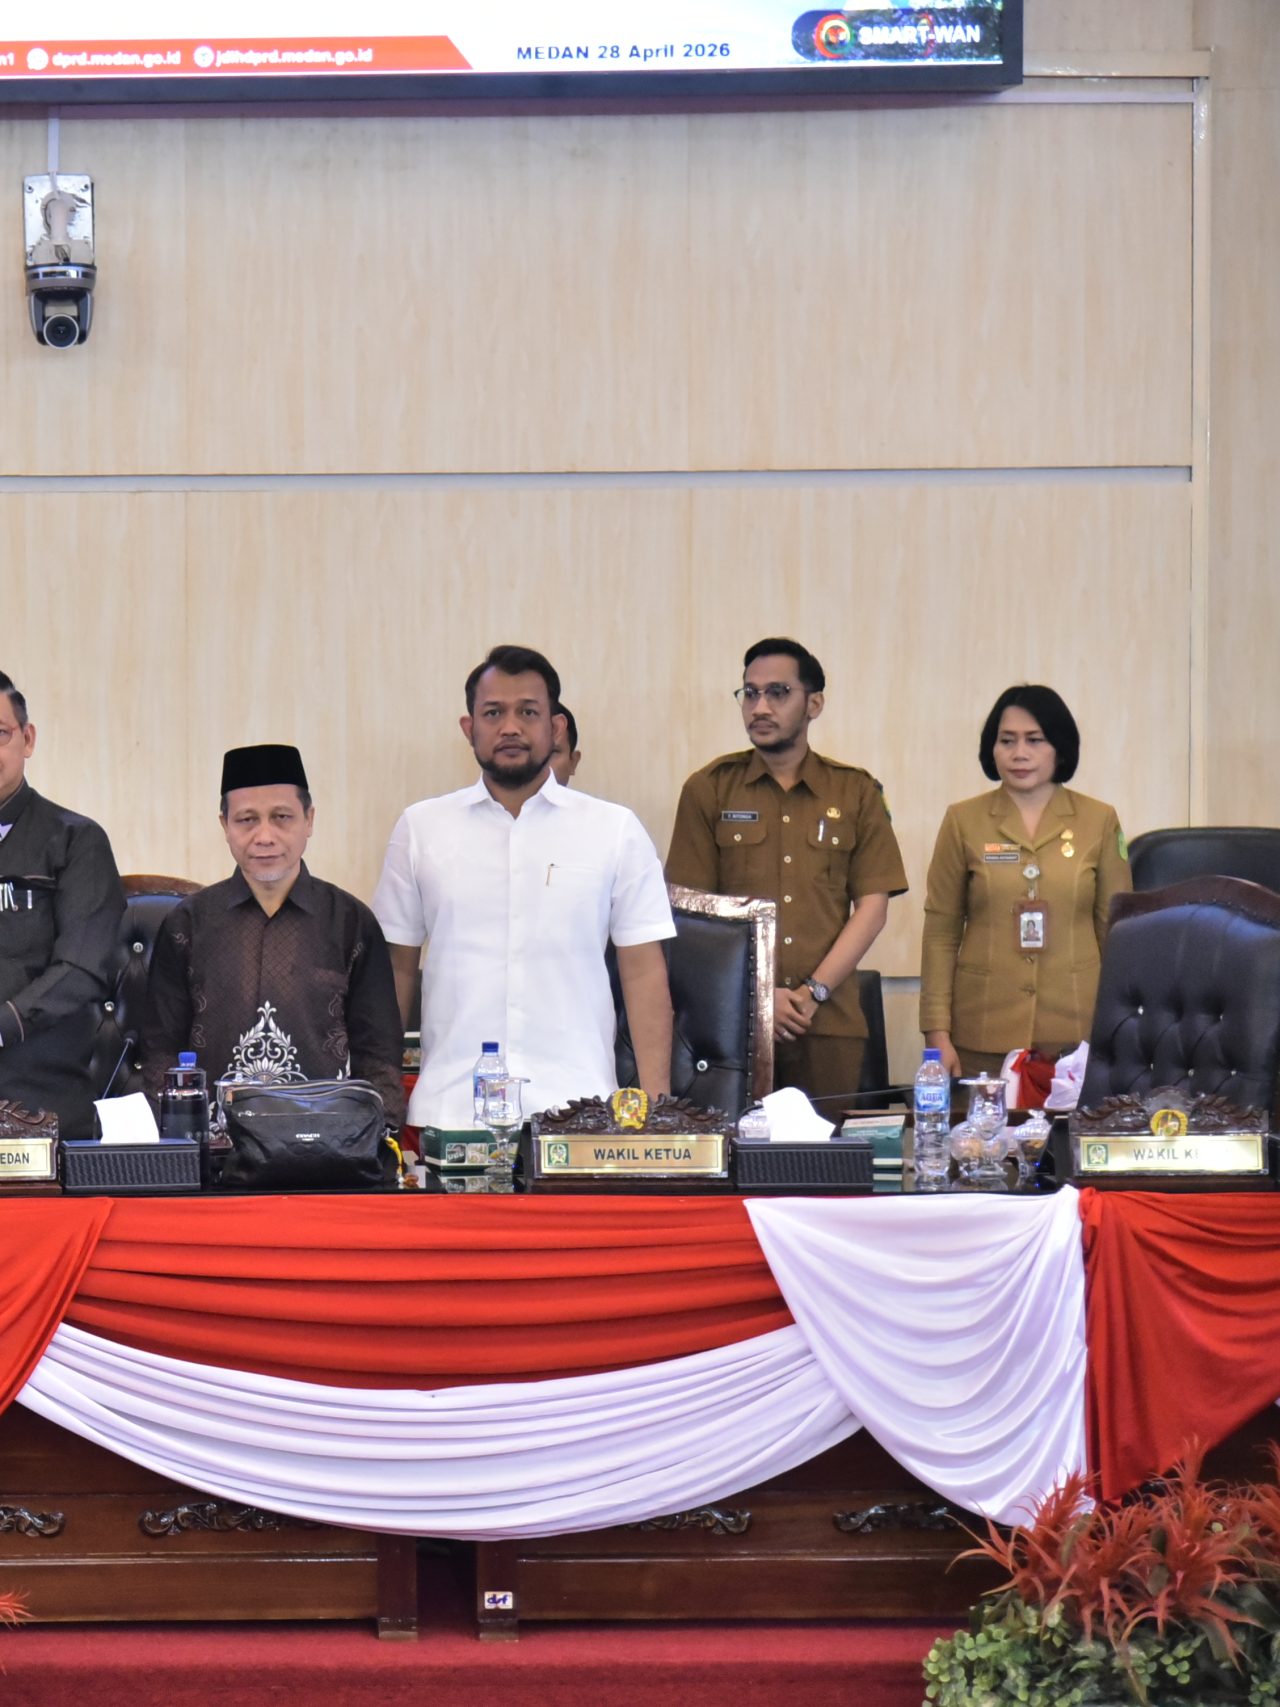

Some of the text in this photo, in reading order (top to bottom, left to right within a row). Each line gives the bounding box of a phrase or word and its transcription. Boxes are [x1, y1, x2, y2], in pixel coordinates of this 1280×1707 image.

[858, 25, 981, 45] SMART-WAN
[517, 43, 731, 61] MEDAN 28 April 2026
[593, 1148, 692, 1161] WAKIL KETUA
[1133, 1148, 1179, 1161] WAKIL
